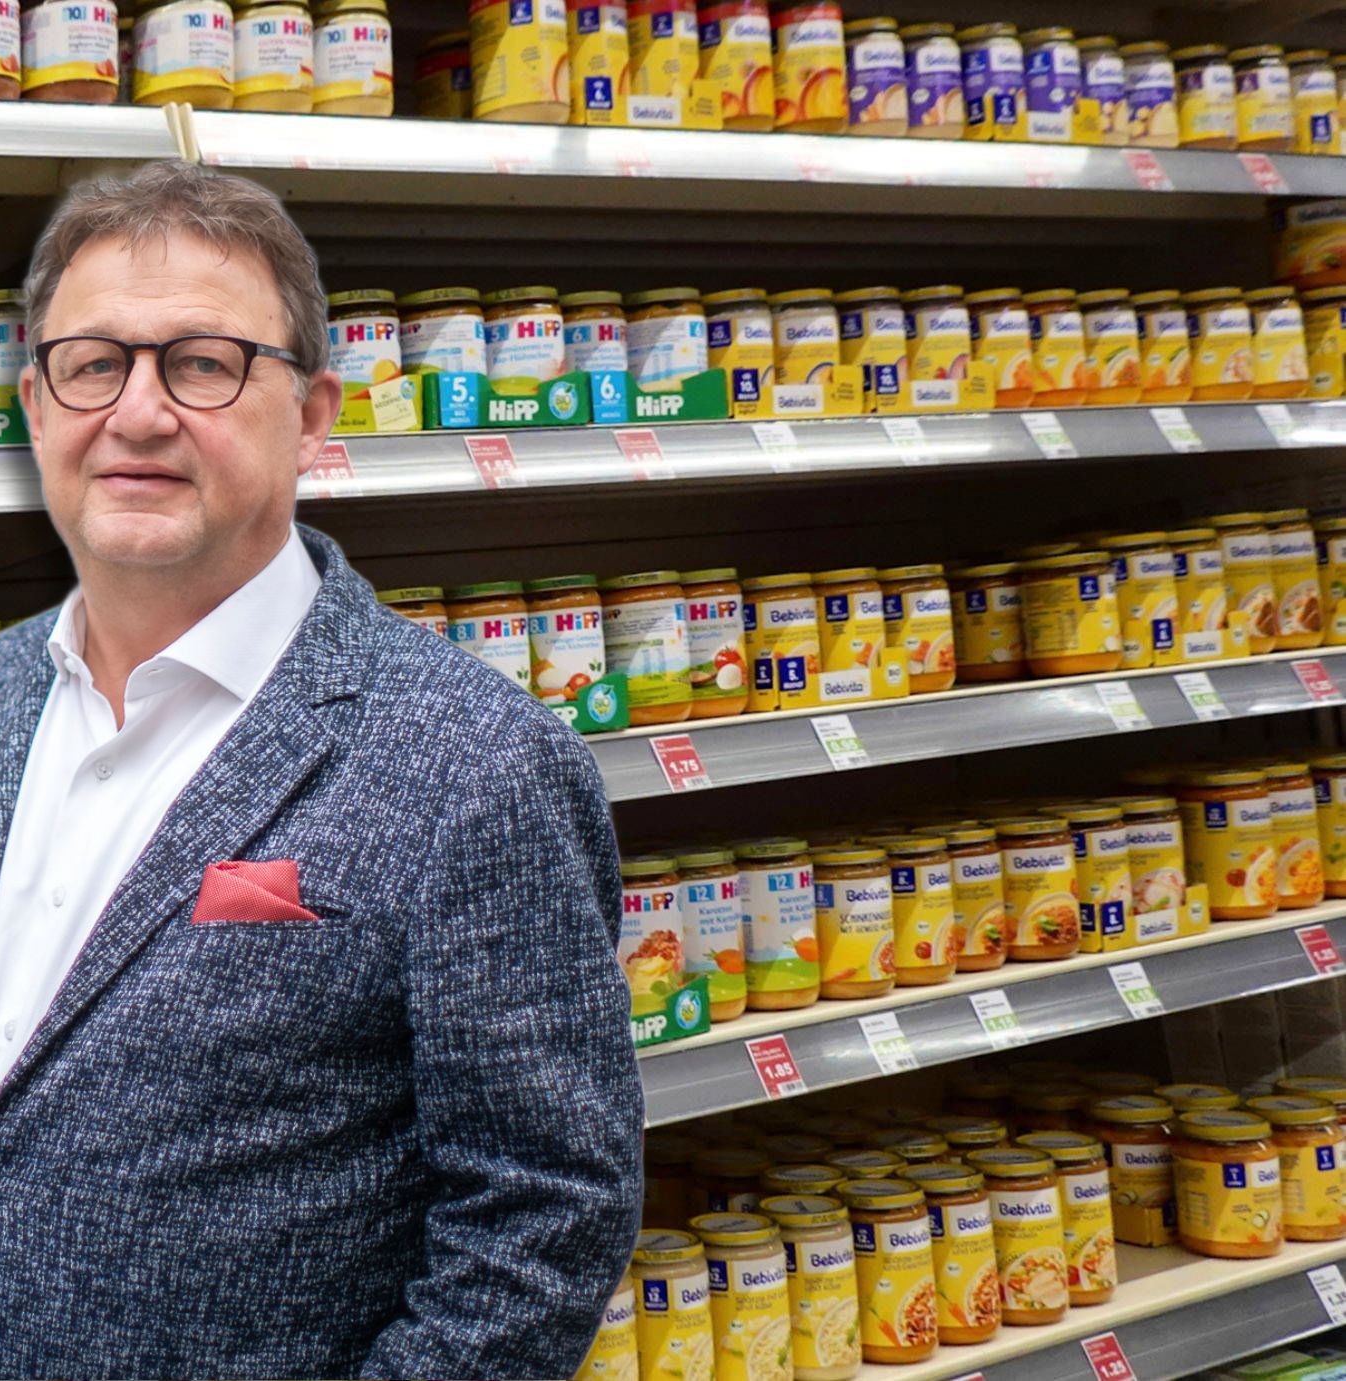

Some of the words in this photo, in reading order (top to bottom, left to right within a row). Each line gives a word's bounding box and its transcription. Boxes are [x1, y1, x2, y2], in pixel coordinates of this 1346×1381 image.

[346, 323, 395, 342] HiPP
[517, 321, 560, 339] HiPP
[452, 377, 475, 402] 5.
[601, 375, 622, 399] 6.
[489, 400, 539, 422] HiPP
[636, 395, 684, 417] HiPP
[689, 601, 737, 621] HiPP
[770, 608, 815, 623] Bebivita
[484, 618, 526, 639] HiPP
[556, 611, 599, 632] HiPP
[824, 682, 864, 694] Bebivita
[668, 757, 699, 774] 1.75
[1014, 855, 1065, 870] Bebivita
[624, 892, 674, 912] HiPP
[846, 887, 889, 902] Bebivita
[1140, 921, 1173, 936] Bebivita
[764, 1062, 794, 1080] 1.85
[1000, 1203, 1053, 1217] Bebivita
